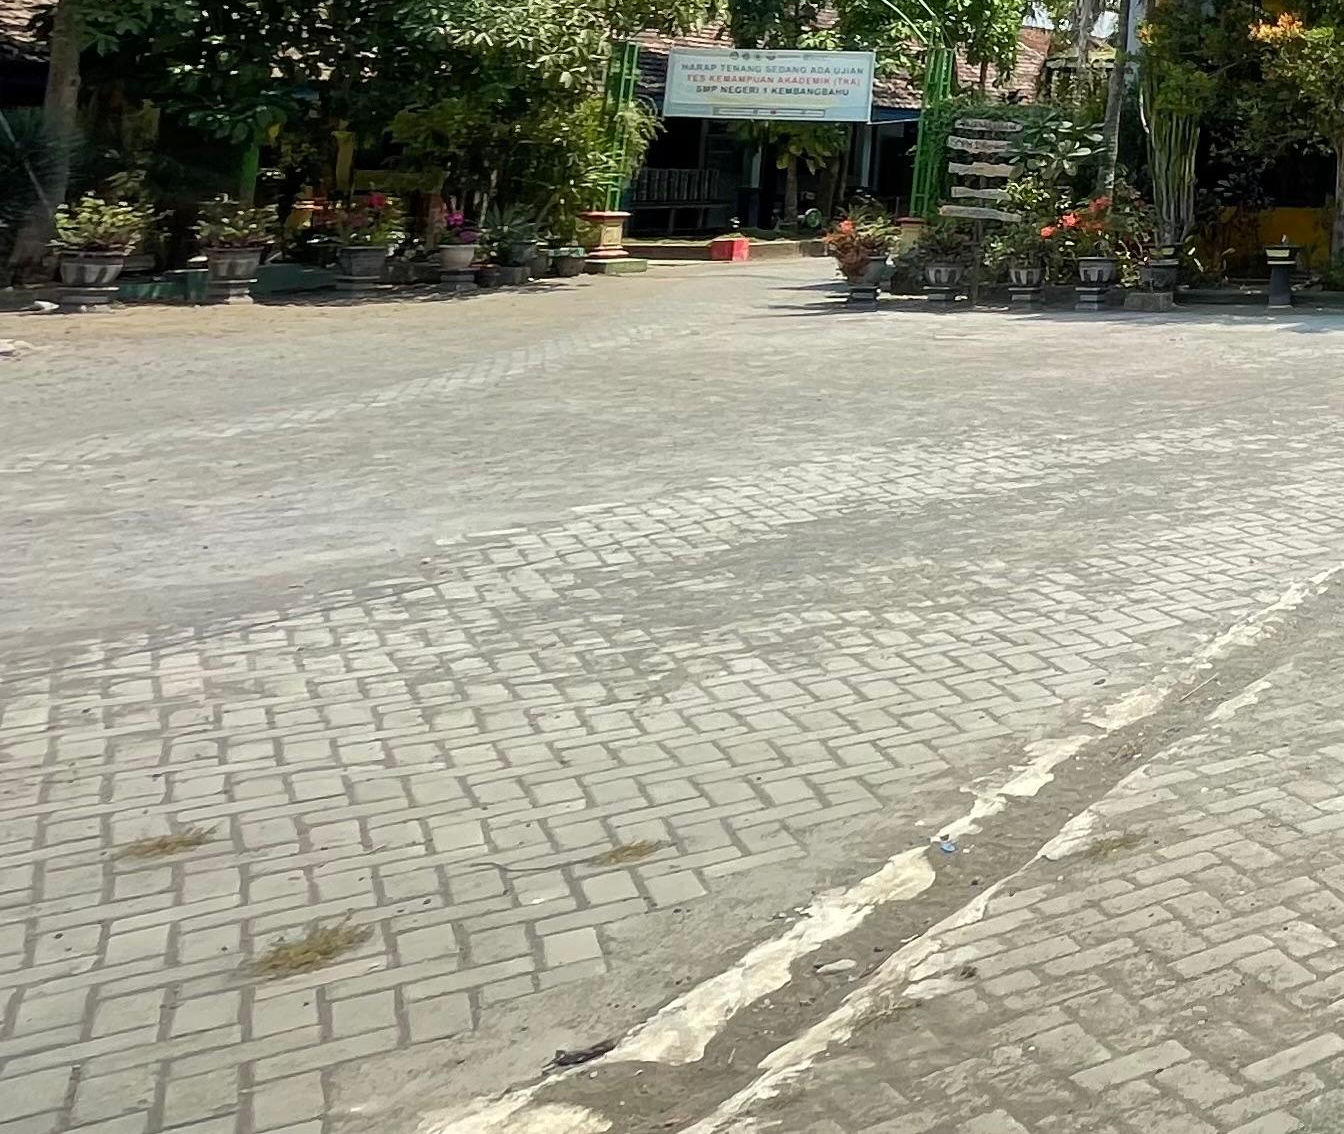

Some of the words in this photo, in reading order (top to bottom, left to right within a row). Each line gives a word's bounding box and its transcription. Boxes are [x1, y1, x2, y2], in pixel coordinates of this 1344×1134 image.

[721, 65, 762, 73] TENANG
[766, 65, 807, 74] SEDANG
[833, 67, 864, 75] UJIAN
[687, 74, 706, 82] TES
[709, 75, 775, 84] KEMAMPUAN
[778, 77, 830, 85] AKADEMIK
[695, 85, 718, 93] SMP
[720, 86, 759, 94] NEGERI
[771, 88, 850, 96] KEMBANGBAHU
